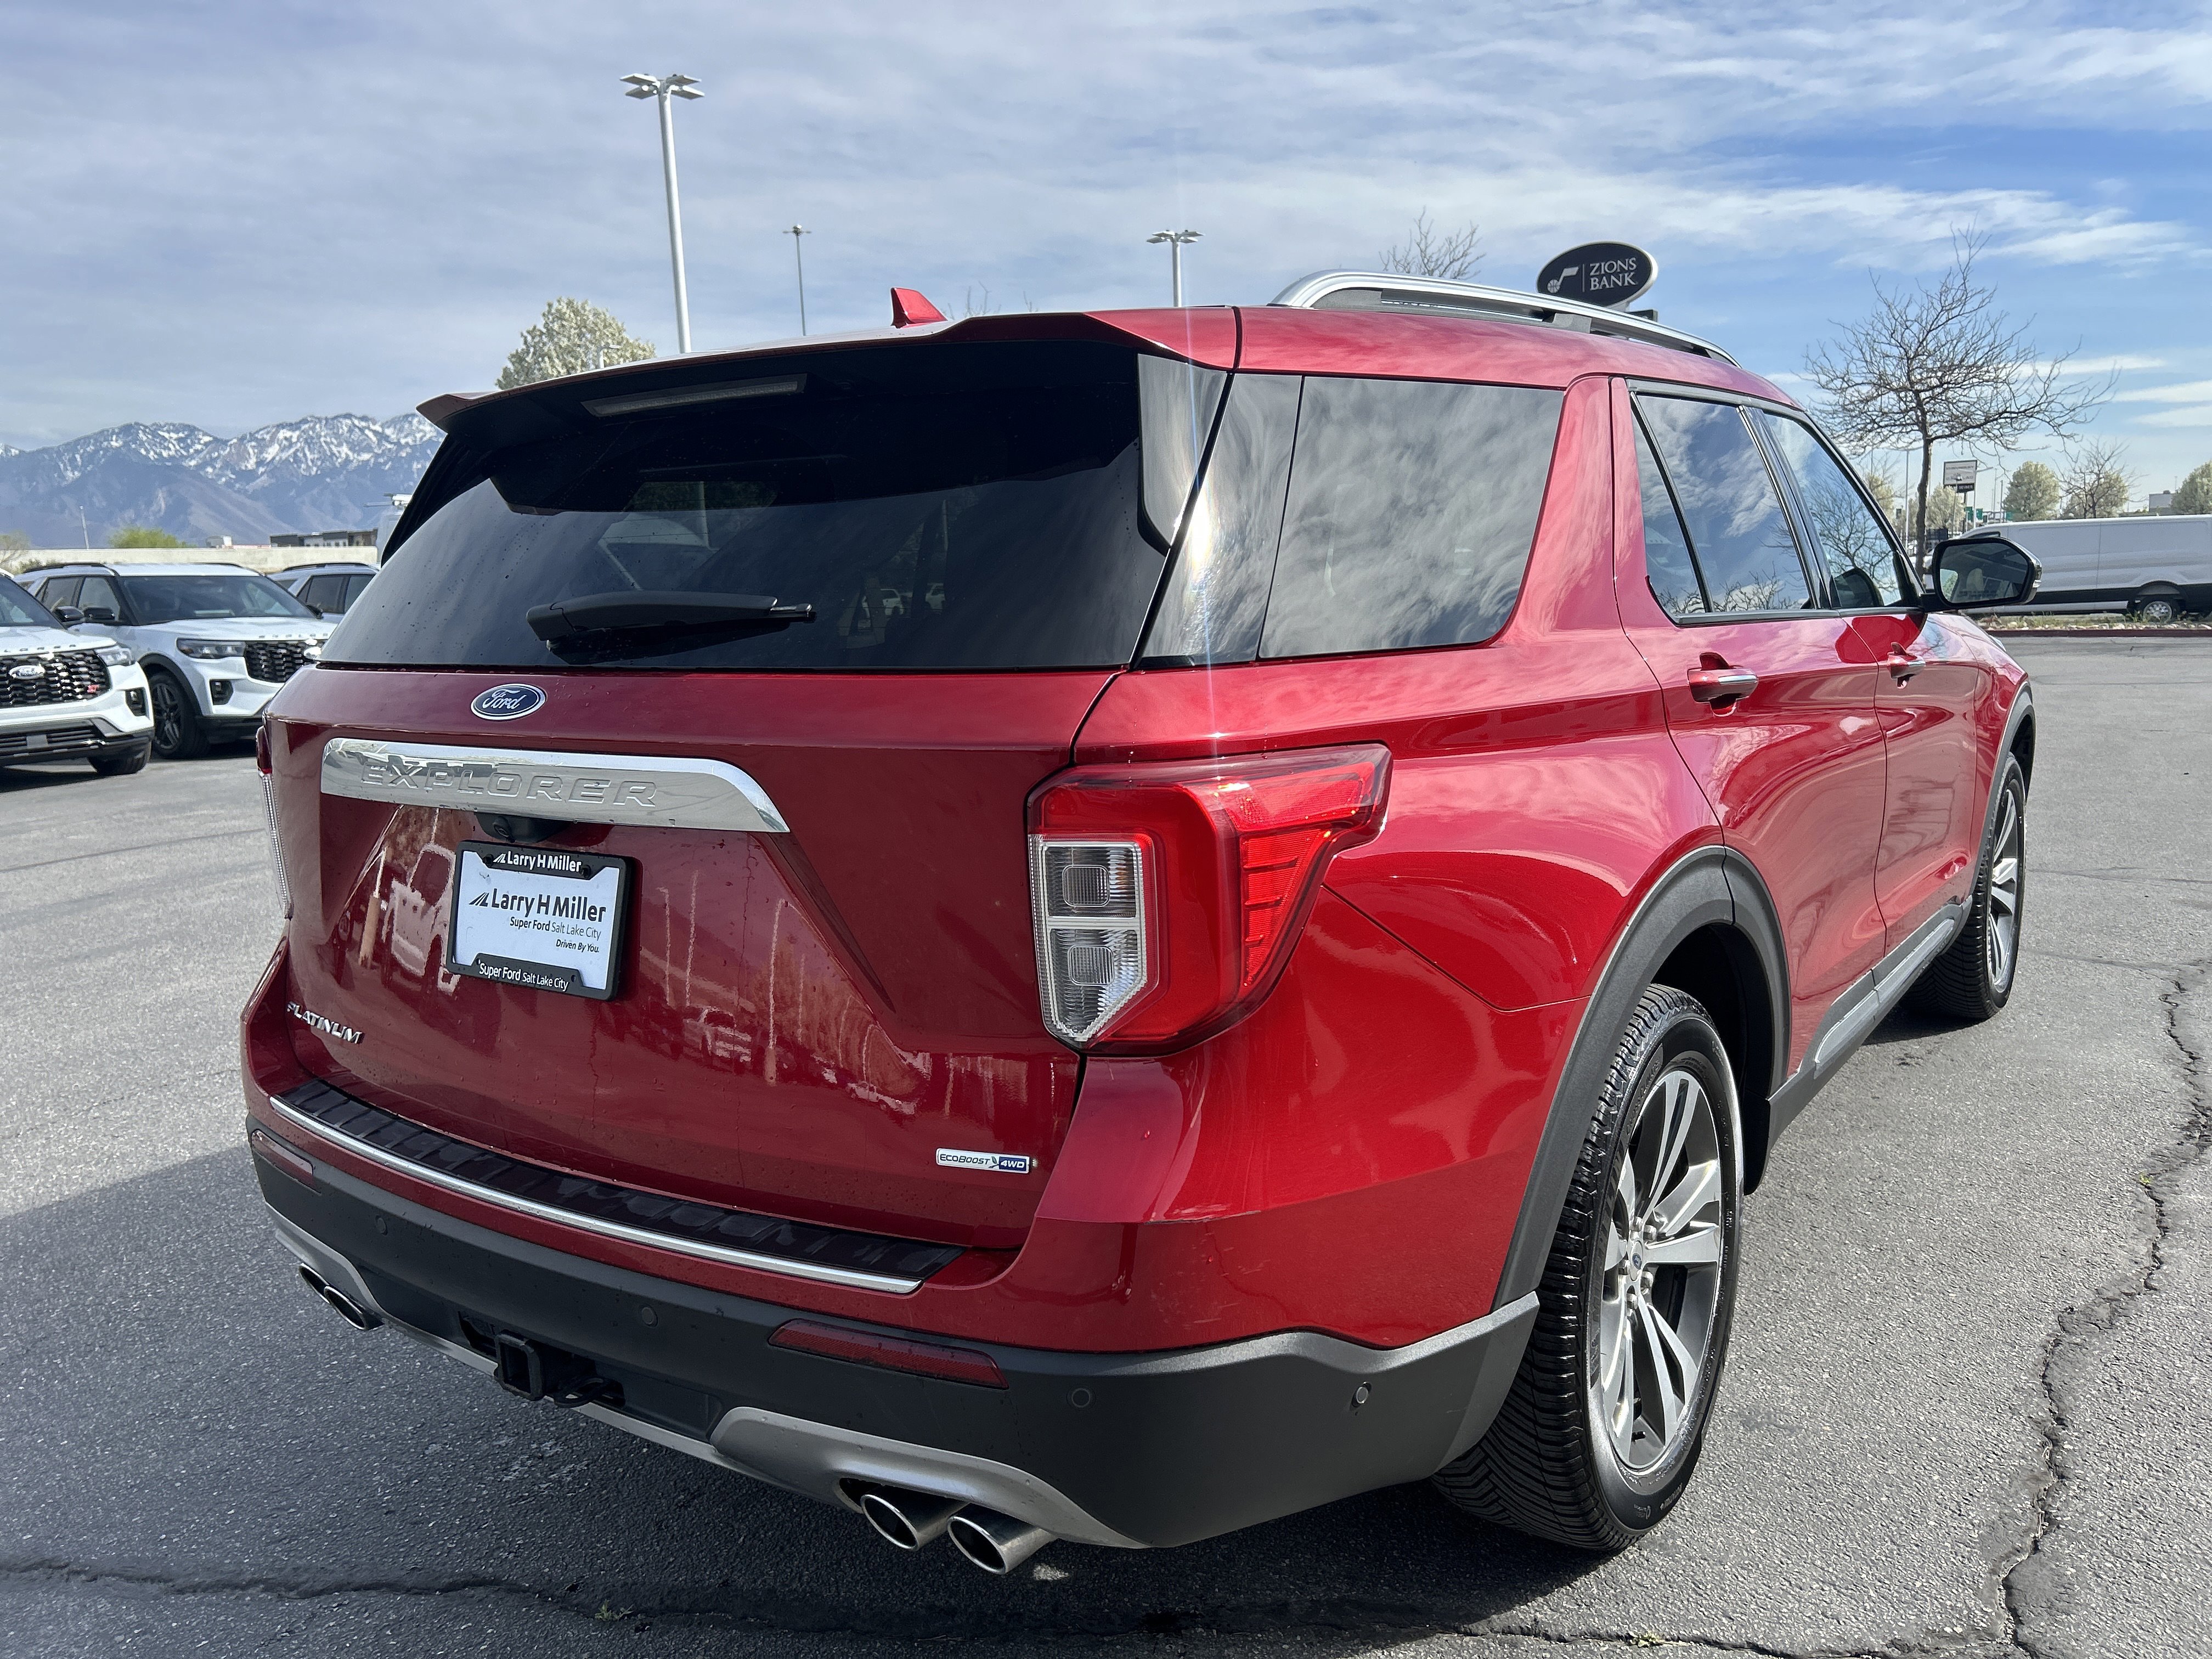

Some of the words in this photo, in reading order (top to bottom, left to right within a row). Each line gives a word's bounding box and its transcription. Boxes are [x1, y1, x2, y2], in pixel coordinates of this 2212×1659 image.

[1589, 257, 1637, 276] ZIONS
[1590, 272, 1637, 291] BANK
[482, 687, 522, 712] Ford
[360, 761, 657, 808] EXPLORER
[507, 851, 536, 870] Larry
[538, 854, 547, 868] H
[548, 855, 582, 872] Miller
[491, 888, 535, 918] Larry
[537, 894, 550, 915] H
[552, 895, 606, 923] Miller
[510, 916, 532, 930] Super
[533, 919, 550, 932] Ford
[551, 922, 565, 934] Salt
[566, 924, 584, 936] Lake
[585, 927, 601, 940] City
[556, 939, 577, 950] Driven
[578, 942, 586, 952] By
[479, 963, 502, 979] Super
[502, 967, 521, 981] Ford
[522, 972, 536, 984] Salt
[537, 974, 553, 987] Lake
[554, 977, 569, 992] City
[287, 1001, 364, 1044] PLATINUM
[940, 1153, 990, 1165] ECOBOOST
[1000, 1159, 1025, 1169] 4WD
